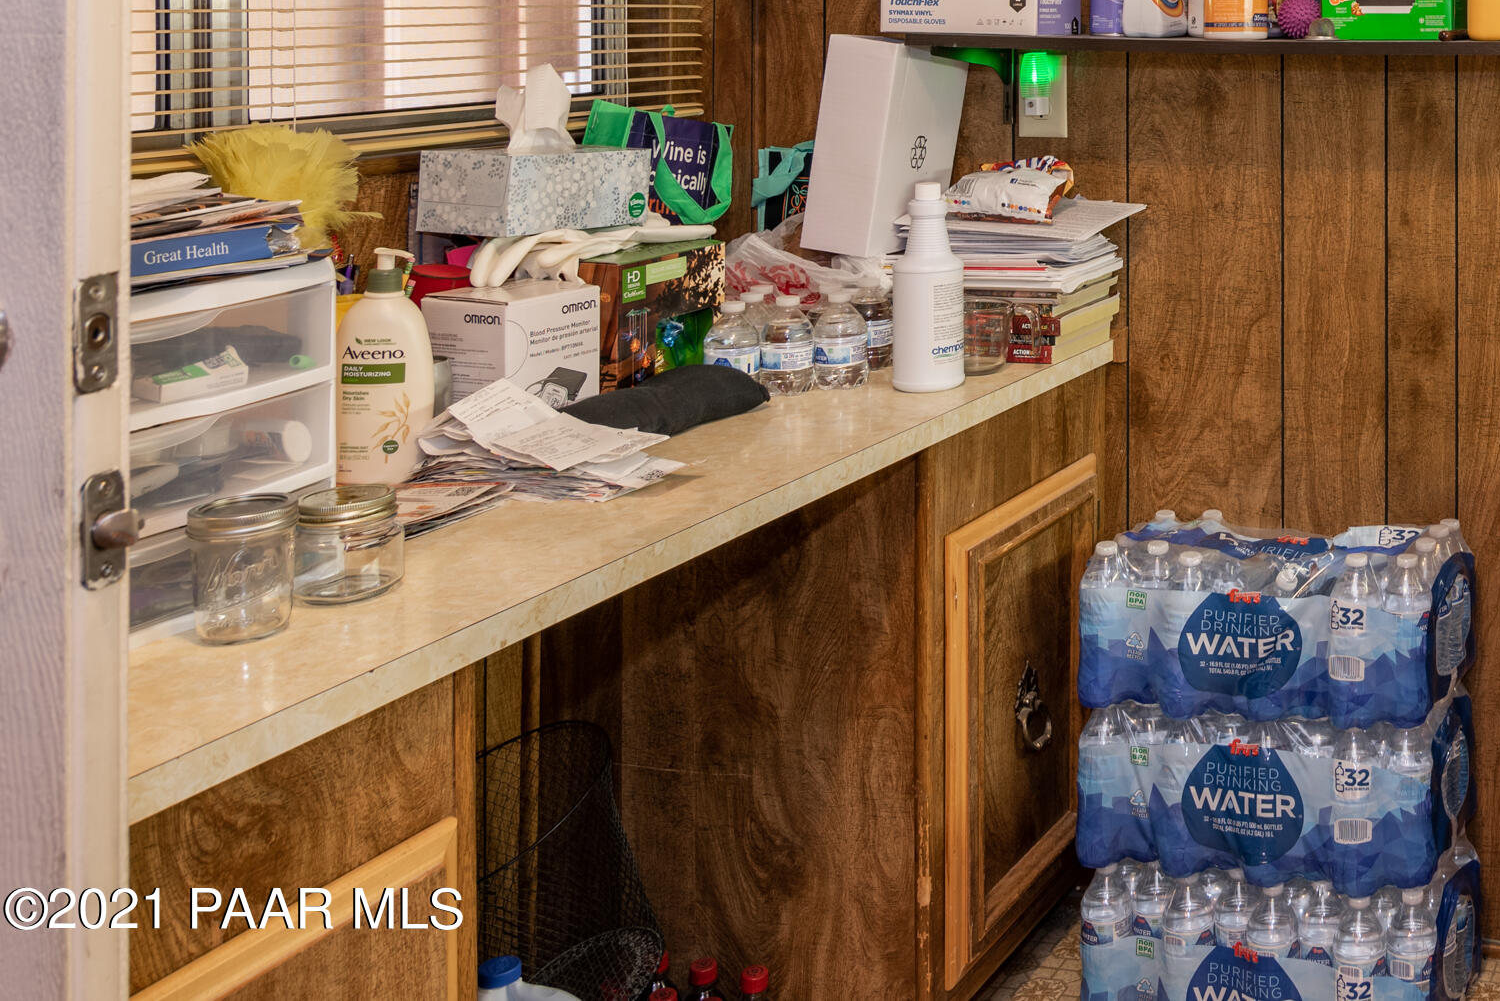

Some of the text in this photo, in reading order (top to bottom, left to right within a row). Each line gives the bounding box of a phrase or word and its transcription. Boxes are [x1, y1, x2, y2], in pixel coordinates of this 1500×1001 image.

[697, 145, 707, 164] is
[144, 241, 229, 265] Great Health
[627, 270, 640, 283] HD
[562, 299, 597, 314] OMRON
[464, 313, 500, 325] OMRON
[530, 319, 591, 337] Blood Pressure Monitor
[530, 335, 551, 345] Monitor
[579, 326, 598, 336] arterial
[342, 346, 403, 359] Aveeno
[1204, 609, 1280, 625] PURIFIED
[1339, 608, 1364, 626] 32
[1201, 620, 1283, 636] DRINKING
[1186, 629, 1295, 658] WATER
[1207, 762, 1279, 779] PURIFIED
[1344, 768, 1370, 786] 32
[1204, 773, 1282, 792] DRINKING
[1189, 785, 1296, 818] WATER
[1209, 962, 1280, 988] PURIFIED
[1207, 973, 1282, 999] DRINKING
[1346, 981, 1371, 999] 32
